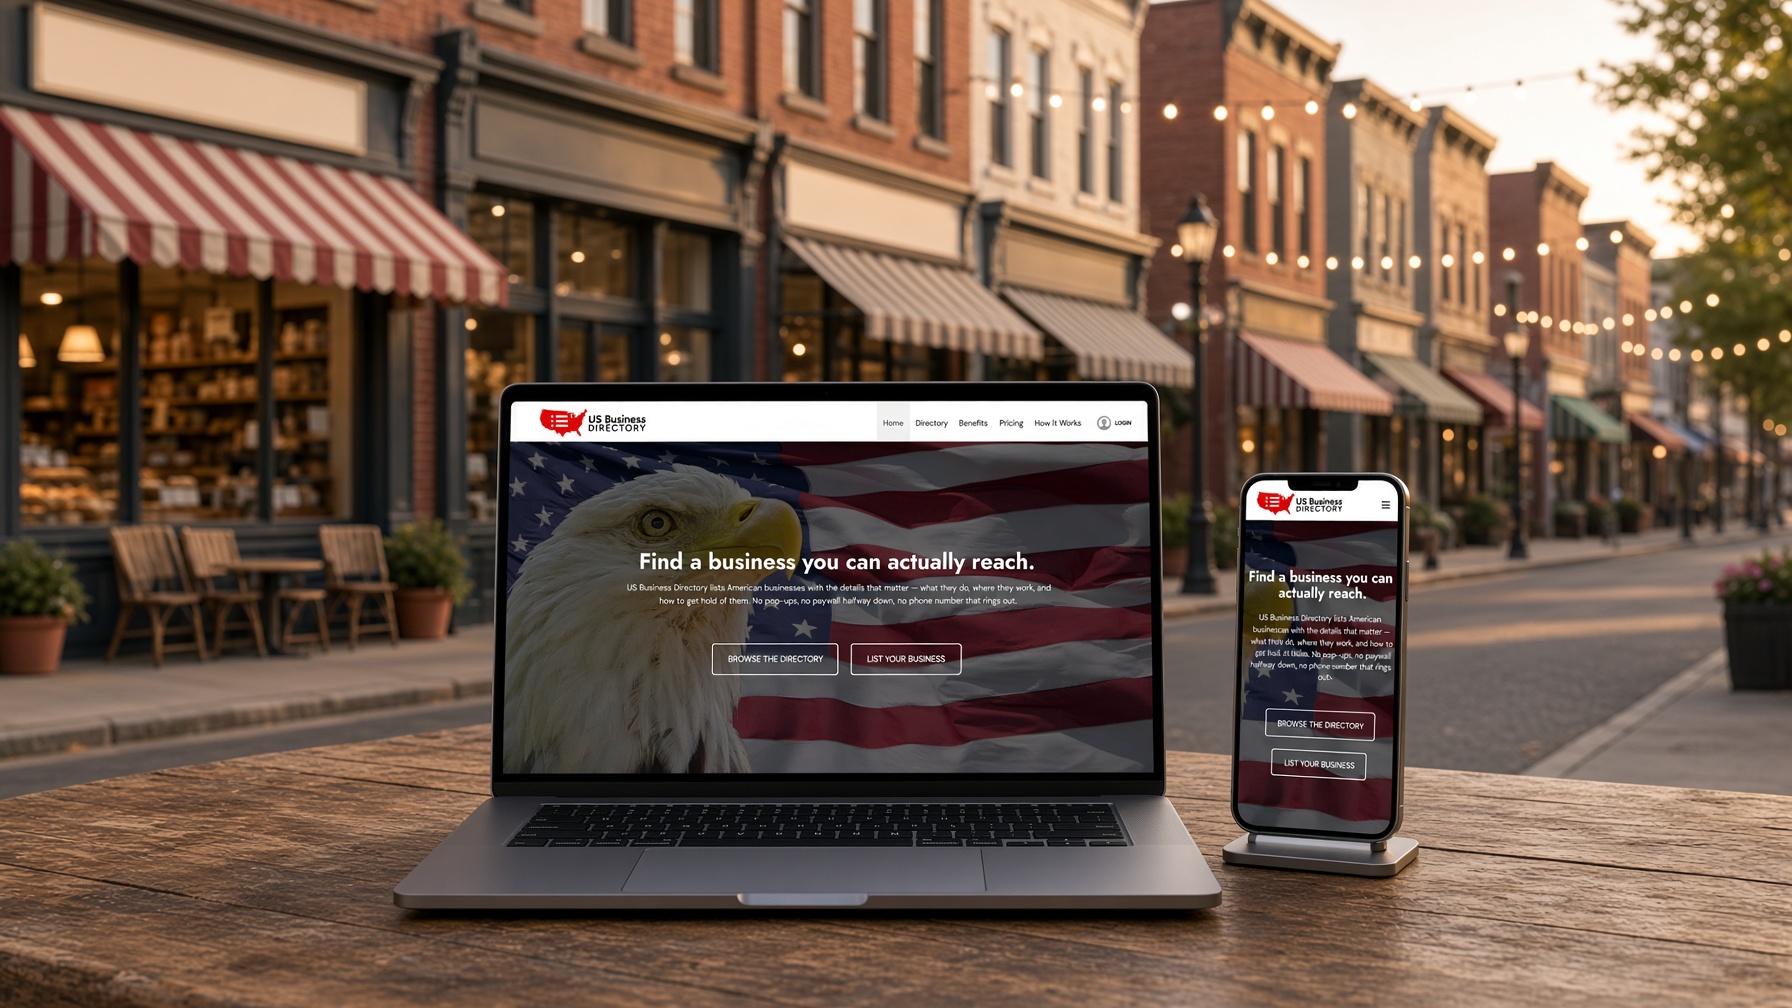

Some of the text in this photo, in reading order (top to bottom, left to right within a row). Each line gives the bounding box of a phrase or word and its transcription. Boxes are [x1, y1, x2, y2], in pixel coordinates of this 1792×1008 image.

[588, 414, 647, 424] US Business
[882, 419, 1082, 429] Home Directory Benefits Pricing How It Works
[588, 424, 646, 432] DIRECTORY
[1309, 497, 1343, 506] Business
[639, 552, 1035, 575] Find a business you can actually reach.
[1249, 570, 1393, 587] Find a business you can
[627, 584, 638, 592] US
[639, 584, 672, 592] Business
[674, 584, 708, 594] Directory
[710, 584, 726, 592] lists
[727, 584, 762, 592] American
[764, 584, 806, 592] businesses
[808, 584, 824, 592] with
[826, 584, 838, 592] the
[840, 584, 864, 592] details
[867, 584, 882, 592] that
[920, 584, 938, 592] what
[940, 584, 957, 594] they
[959, 584, 970, 593] do,
[972, 584, 995, 592] where
[997, 584, 1014, 594] they
[1016, 584, 1036, 593] work,
[1037, 584, 1052, 592] and
[1278, 586, 1367, 602] actually reach.
[659, 597, 674, 605] how
[686, 598, 699, 606] get
[700, 597, 718, 605] hold
[720, 597, 728, 605] of
[812, 597, 842, 606] paywall
[844, 597, 871, 606] halfway
[873, 597, 895, 606] down,
[909, 597, 932, 606] phone
[934, 597, 963, 605] number
[966, 597, 980, 605] that
[982, 597, 1000, 606] rings
[1348, 614, 1382, 623] American
[1307, 626, 1318, 634] the
[1344, 627, 1358, 635] that
[1359, 628, 1382, 636] matter
[1355, 639, 1368, 647] and
[728, 655, 824, 663] BROWSE THE DIRECTORY
[867, 655, 946, 663] LIST YOUR BUSINESS
[1360, 662, 1373, 670] that
[1277, 720, 1364, 730] BROWSE THE DIRECTORY
[1284, 759, 1299, 767] LIST
[1320, 761, 1356, 770] BUSINESS
